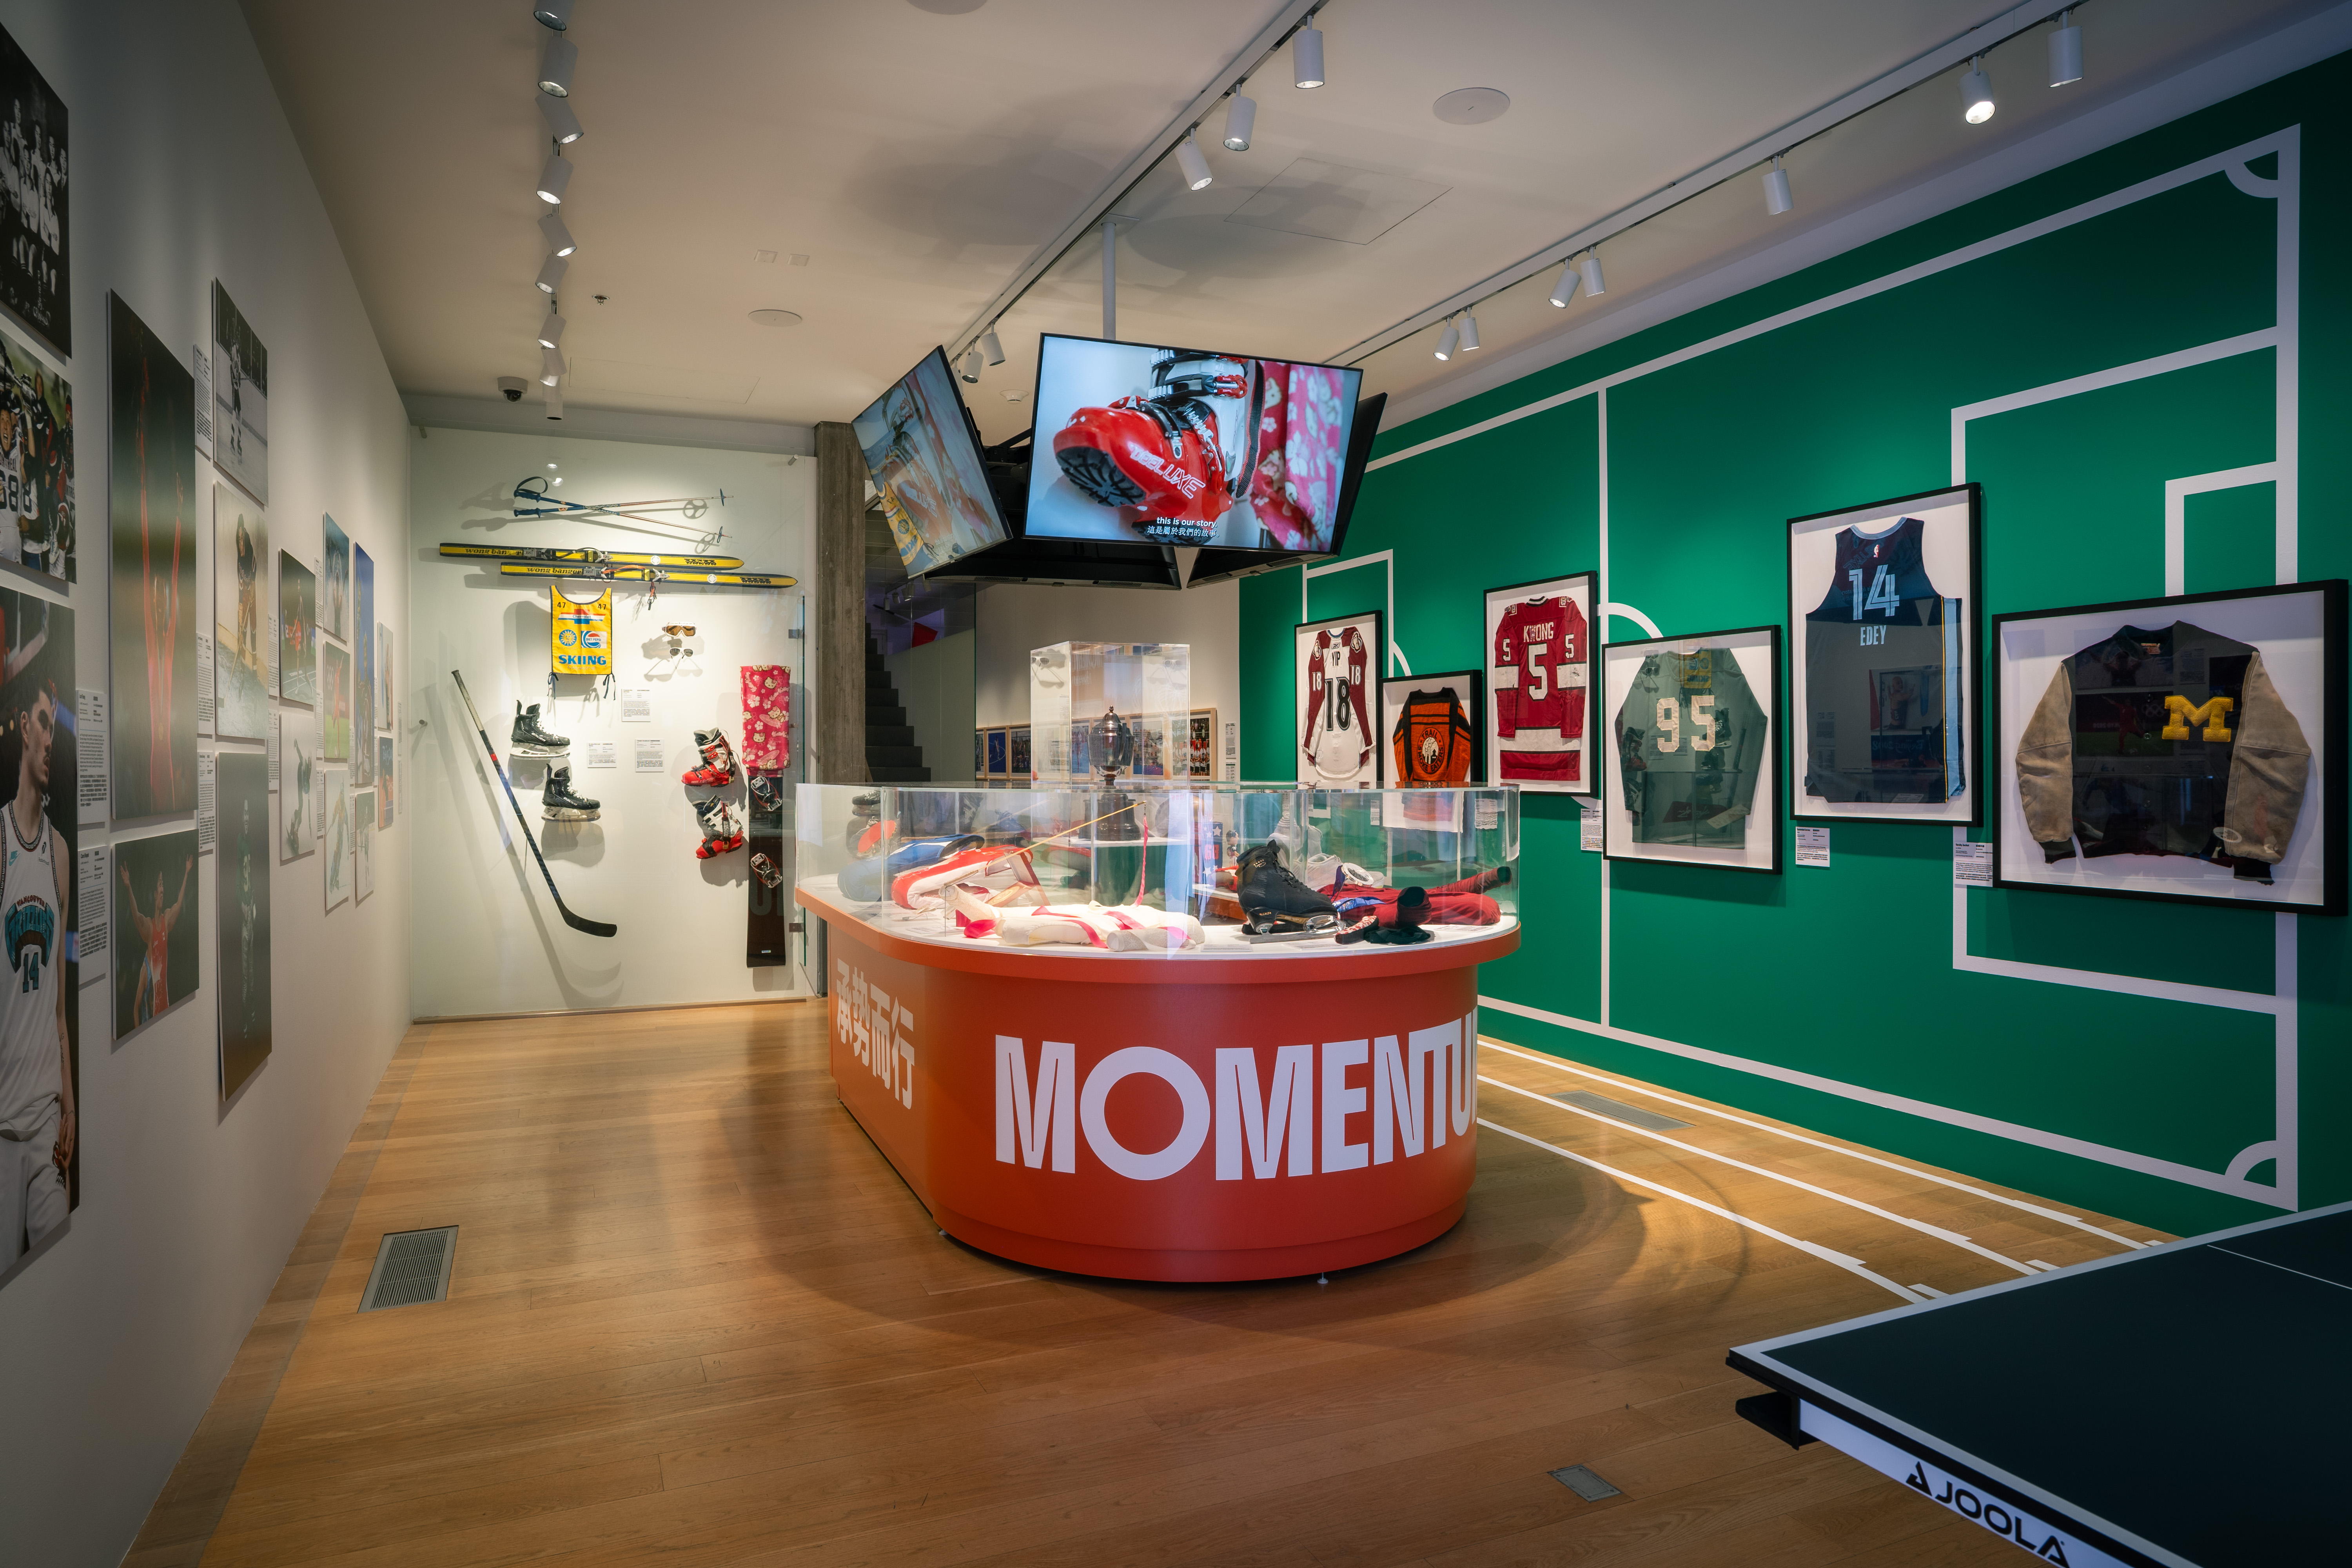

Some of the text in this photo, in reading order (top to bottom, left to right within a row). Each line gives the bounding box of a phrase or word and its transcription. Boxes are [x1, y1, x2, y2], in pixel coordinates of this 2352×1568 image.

[1130, 445, 1206, 499] DEELUXE
[1147, 525, 1220, 537] 這是屬於我們的故事。
[1196, 519, 1218, 528] story.
[1849, 564, 1900, 621] 14
[1523, 622, 1554, 642] KWONG
[1860, 625, 1887, 646] EDEY
[1332, 651, 1341, 666] YIP
[1503, 638, 1511, 662] 5
[1565, 633, 1574, 659] 5
[558, 655, 606, 665] SKIING
[1527, 642, 1548, 701] 5
[1312, 671, 1322, 691] 18
[1351, 665, 1361, 686] 18
[1325, 676, 1351, 731] 18
[1656, 695, 1716, 753] 95
[2162, 695, 2234, 742] M
[1421, 729, 1438, 740] TRAIL
[1417, 746, 1444, 772] SMOKE EATERS
[16, 895, 45, 908] VANCOUVER
[23, 952, 39, 994] 14
[995, 1006, 1477, 1180] MOMENTU
[1936, 1481, 2071, 1568] JOOLA
